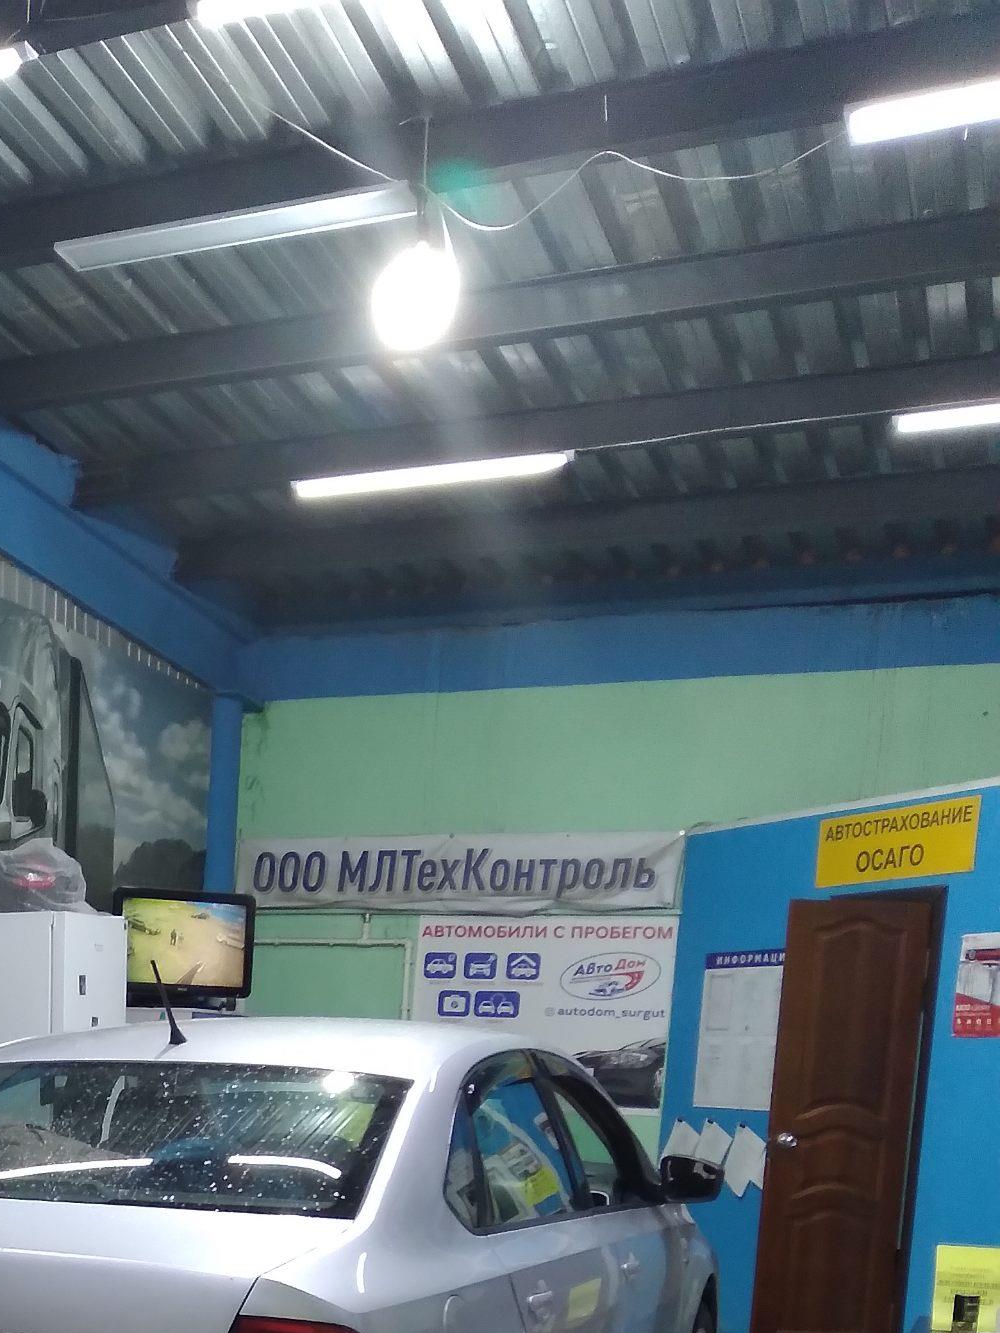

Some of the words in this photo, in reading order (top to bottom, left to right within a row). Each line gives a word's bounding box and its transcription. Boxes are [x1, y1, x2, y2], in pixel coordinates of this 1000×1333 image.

[825, 805, 973, 842] АВТОСТРАХОВАНИЕ
[253, 850, 327, 893] ООО
[337, 847, 657, 898] МЛТехКонтроль
[856, 843, 925, 873] ОСАГО
[422, 925, 547, 939] АВТОМОБИЛИ
[553, 925, 565, 939] С
[571, 925, 673, 940] ПРОБЕГОМ
